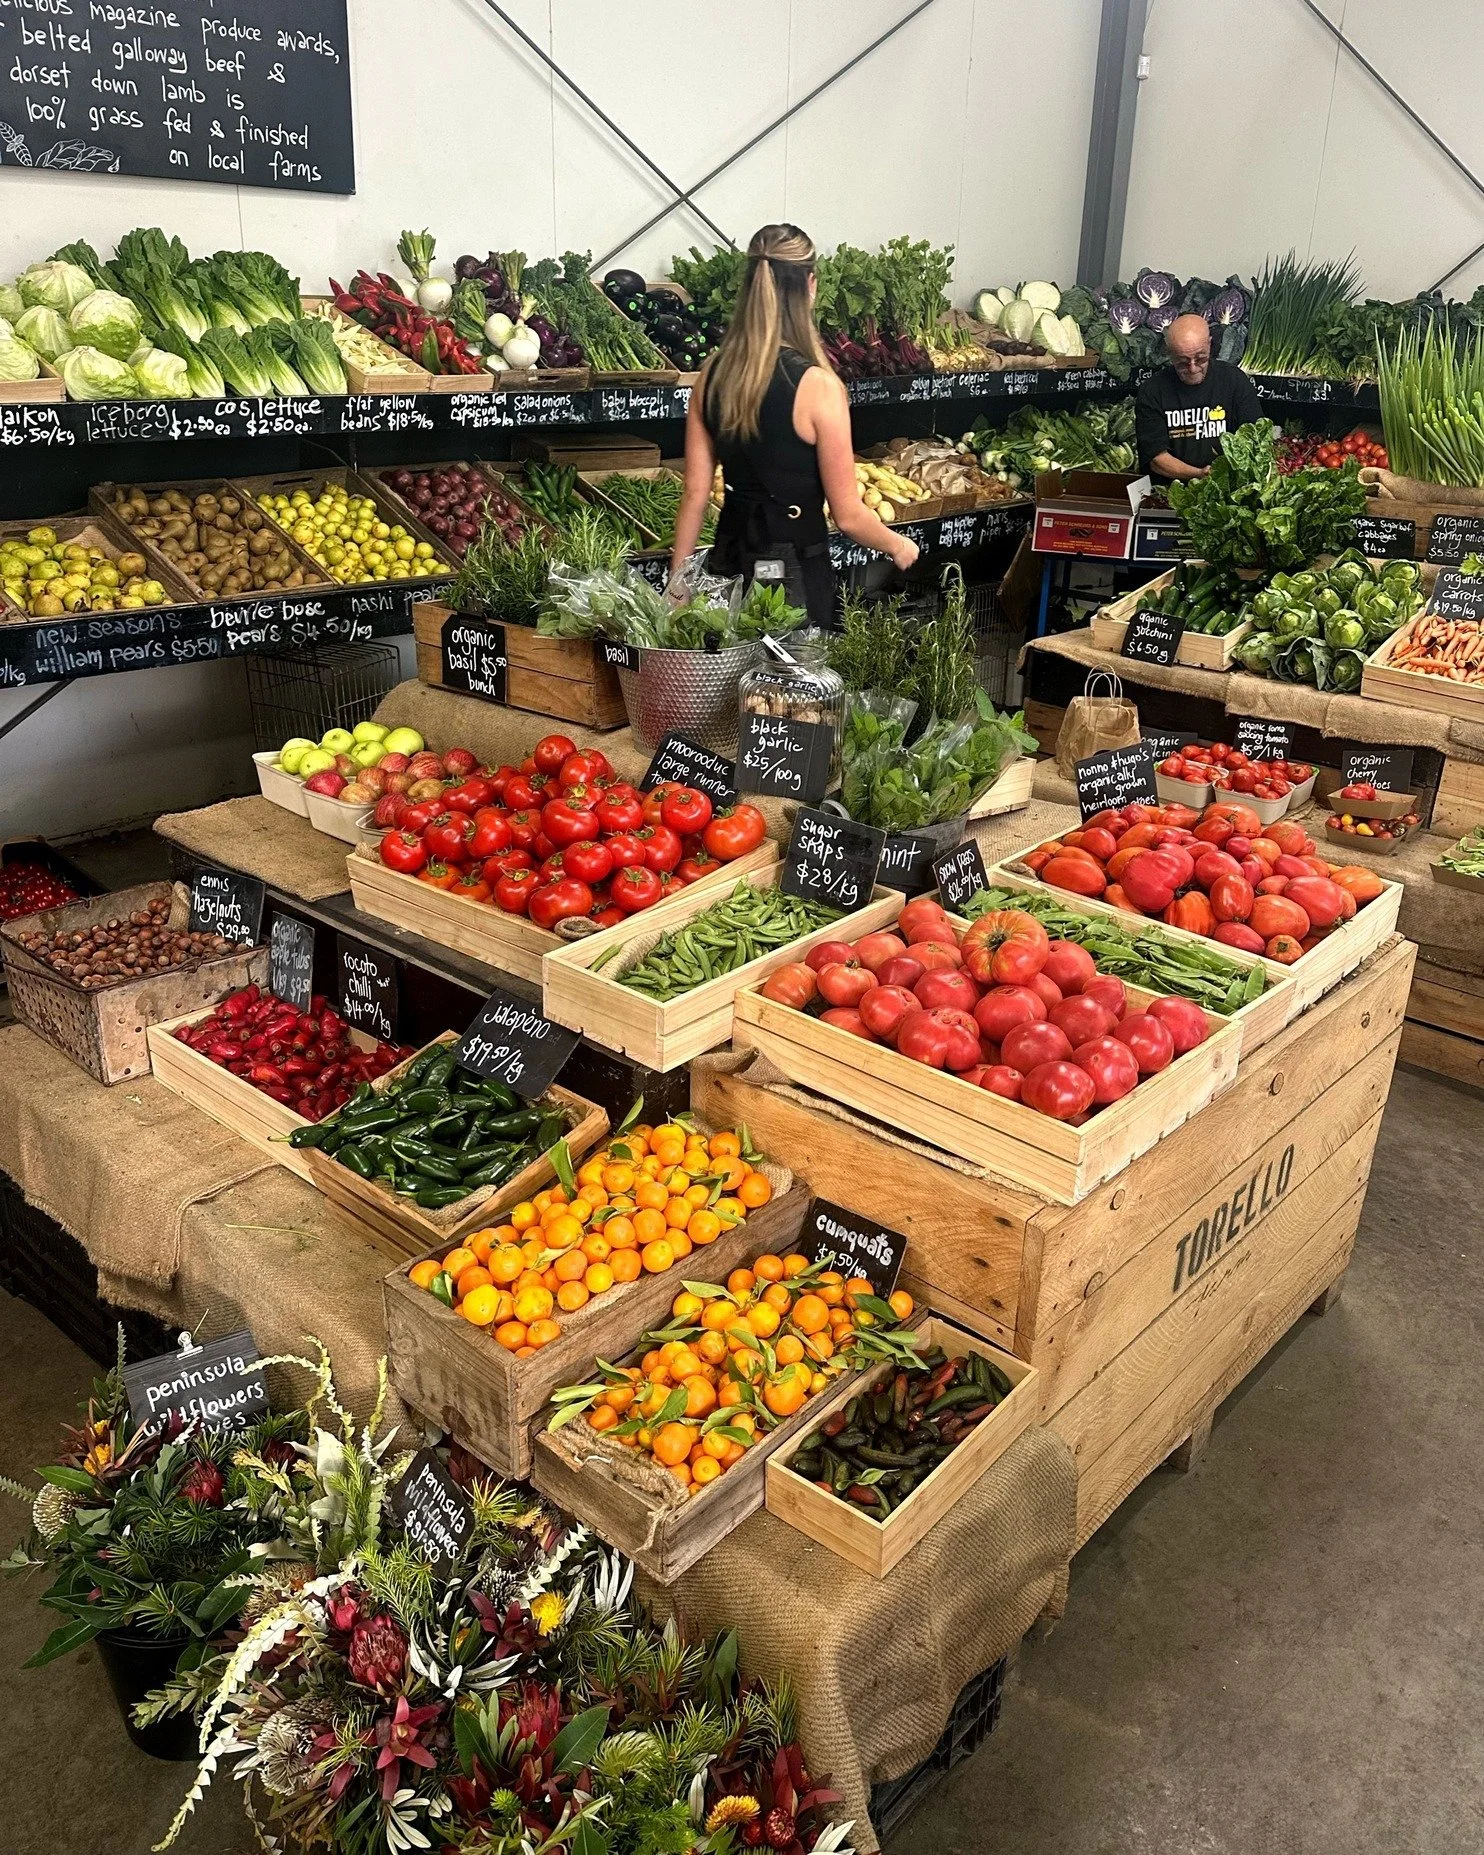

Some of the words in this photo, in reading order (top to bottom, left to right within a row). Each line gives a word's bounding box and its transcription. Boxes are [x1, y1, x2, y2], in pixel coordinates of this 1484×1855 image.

[90, 1, 180, 29] magazine
[201, 18, 262, 44] produce
[277, 30, 340, 64] awards,
[21, 17, 91, 53] belted
[112, 37, 188, 73] galloway
[205, 50, 246, 80] beef
[267, 63, 286, 83] &
[10, 56, 71, 88] dorset
[91, 70, 138, 96] down
[162, 76, 206, 104] lamb
[227, 89, 245, 110] is
[26, 96, 66, 129] 100%
[89, 106, 144, 131] grass
[163, 108, 191, 139] fed
[210, 122, 225, 138] &
[236, 116, 309, 149] finished
[169, 150, 189, 167] on
[208, 145, 245, 174] local
[268, 154, 322, 182] farms
[215, 400, 250, 416] cos
[258, 397, 322, 418] lettuce
[345, 396, 373, 417] flat
[451, 394, 490, 411] organic
[492, 392, 507, 405] red
[541, 394, 571, 407] onions
[602, 390, 626, 411] baby
[629, 388, 664, 407] broccoli
[0, 405, 60, 428] aikon
[92, 402, 170, 428] iceberg
[341, 412, 381, 431] beans
[86, 420, 153, 441] lettuce
[1196, 420, 1227, 440] FARM
[1357, 530, 1397, 543] cabbages
[1436, 517, 1480, 534] organic
[1431, 529, 1461, 549] spring
[1443, 573, 1483, 589] organic
[351, 590, 394, 613] nashi
[1442, 589, 1484, 602] carrots
[1138, 612, 1169, 630] organic
[1433, 600, 1476, 619] $19.50/kg
[35, 625, 78, 648] new
[226, 624, 282, 650] pears
[451, 627, 496, 655] organic
[35, 645, 103, 674] william
[110, 640, 166, 668] pears
[447, 647, 477, 672] basil
[481, 653, 508, 681] $5.50
[604, 644, 629, 666] basil
[466, 671, 496, 696] bunch
[755, 672, 784, 684] black
[788, 681, 817, 692] garlic
[750, 718, 789, 735] black
[1239, 721, 1265, 734] organic
[1268, 724, 1286, 733] roma
[752, 736, 804, 753] garlic
[1264, 733, 1289, 744] tomato
[665, 738, 729, 775] moorooduc
[1350, 754, 1392, 769] organic
[657, 752, 690, 780] large
[693, 772, 736, 797] runner
[1078, 763, 1109, 779] nonno
[1079, 766, 1136, 796] organically
[1115, 777, 1147, 797] grown
[1082, 794, 1127, 813] heirloom
[800, 818, 843, 843] sugar
[798, 835, 845, 867] snaps
[939, 858, 957, 884] snow
[957, 849, 976, 877] peas
[200, 875, 229, 892] ennis
[796, 859, 858, 905] $28/kg
[193, 886, 241, 923] hazelnuts
[273, 921, 301, 947] organic
[343, 952, 378, 977] rocoto
[348, 972, 372, 1000] chilli
[462, 1034, 525, 1084] $19.50/kg
[1173, 1143, 1295, 1293] TORELLO
[815, 1214, 894, 1266] cumquats
[146, 1356, 246, 1412] peninsula
[416, 1463, 466, 1533] peninsula
